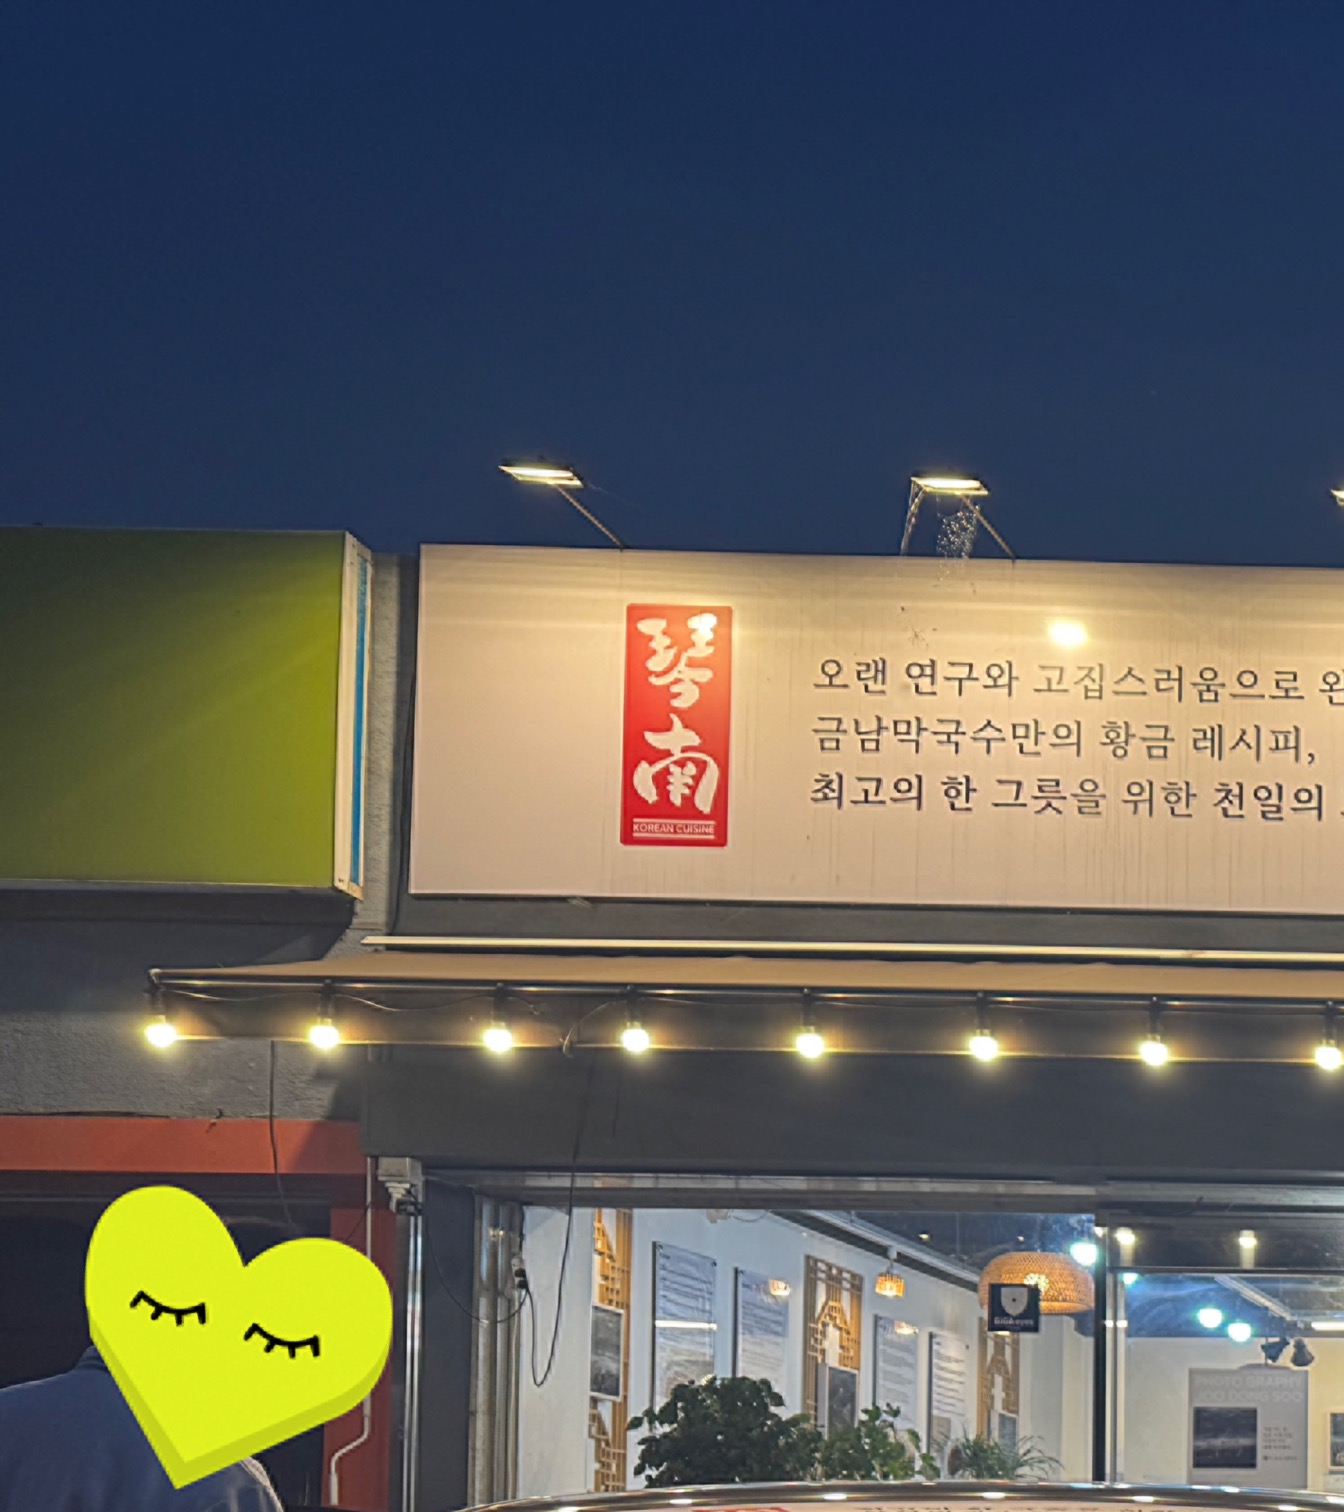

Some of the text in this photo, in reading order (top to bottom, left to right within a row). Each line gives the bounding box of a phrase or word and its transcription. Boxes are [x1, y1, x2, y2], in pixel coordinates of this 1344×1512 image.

[813, 657, 887, 695] 오랜
[905, 658, 1019, 698] 연구와
[1033, 662, 1305, 703] 고집스러움으로
[811, 714, 1316, 765] 금남막국수만의 황금 레시피,
[809, 771, 925, 812] 최고의
[939, 774, 978, 813] 한
[991, 777, 1107, 816] 그릇을
[1120, 779, 1198, 819] 위한
[1213, 781, 1324, 823] 천일의
[633, 822, 715, 835] KOREAN CUISINE
